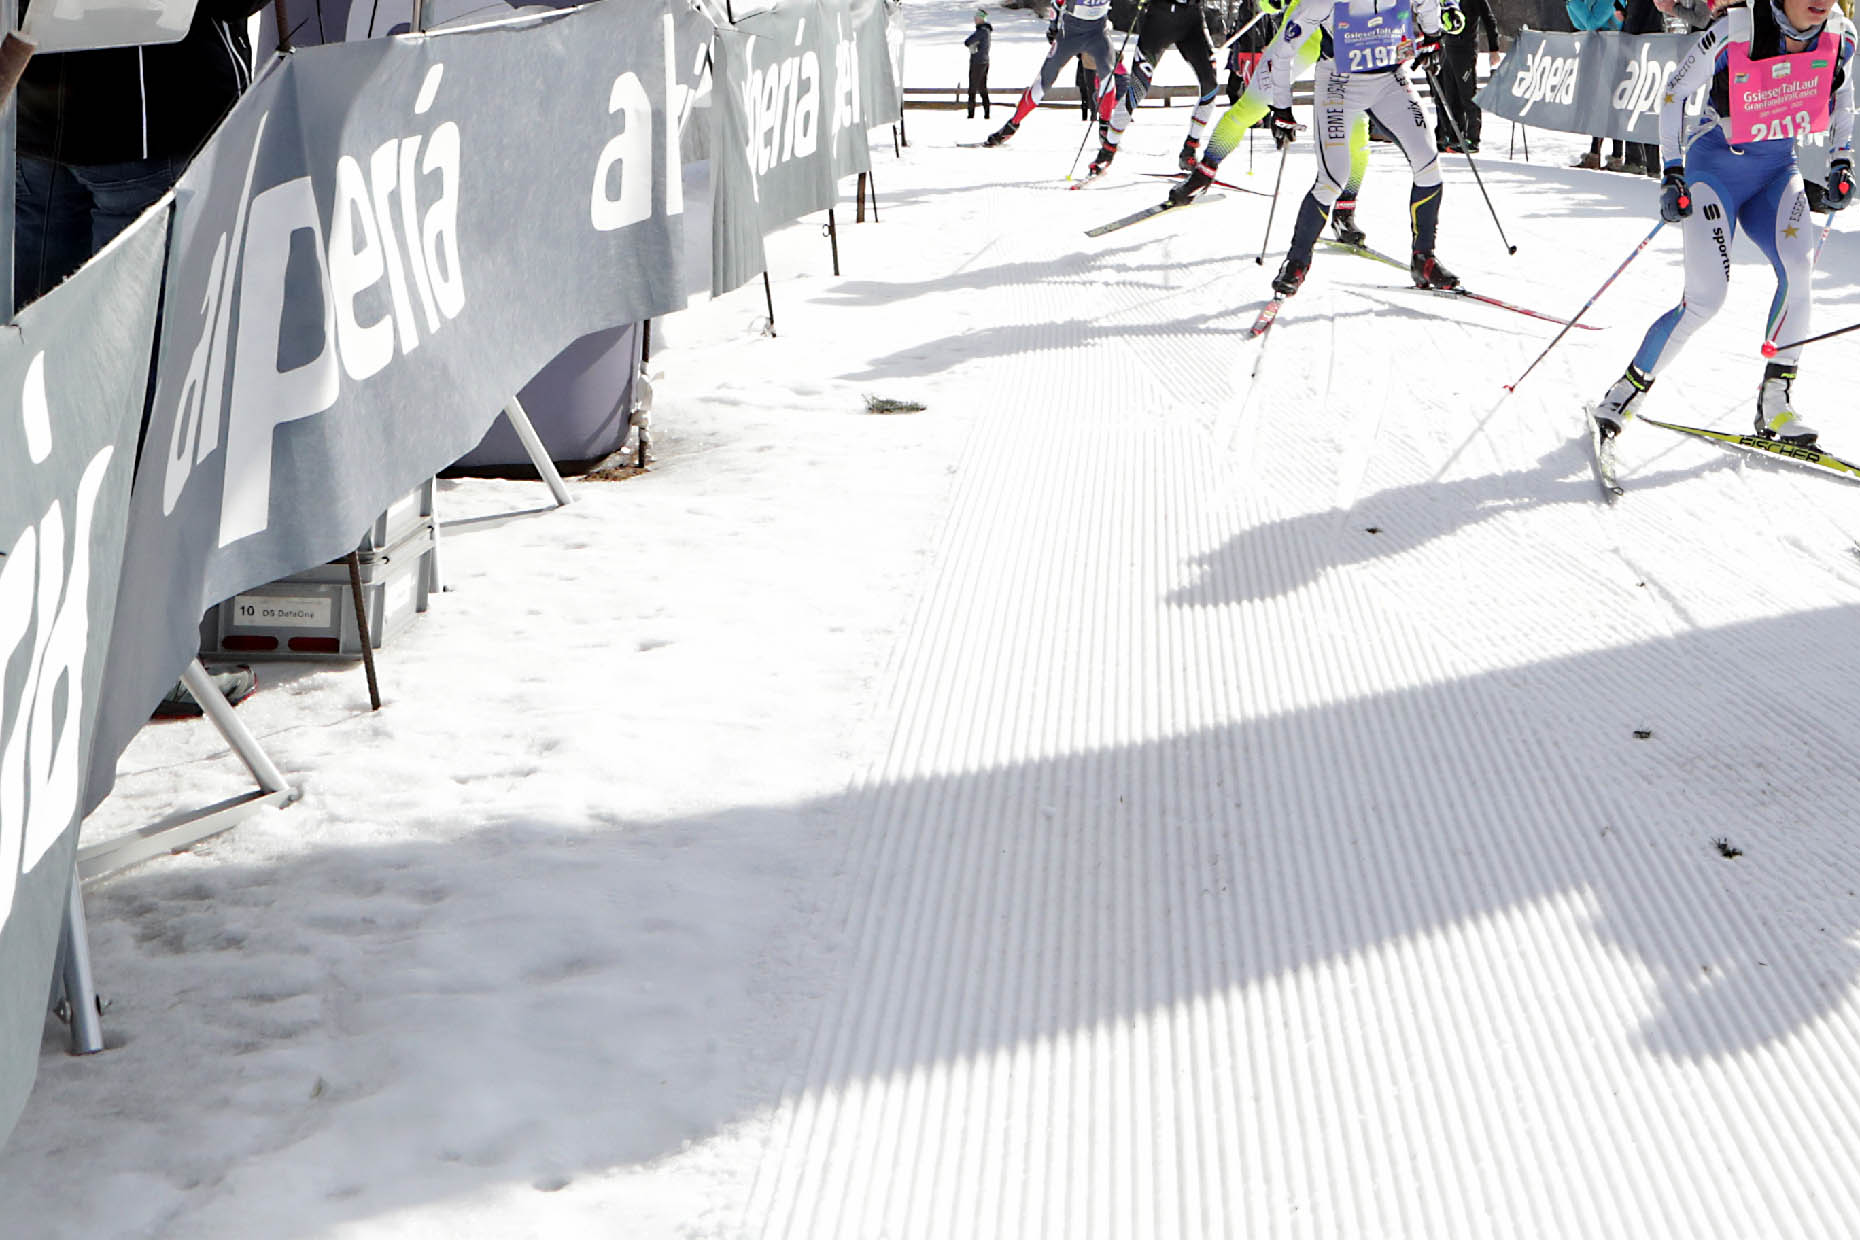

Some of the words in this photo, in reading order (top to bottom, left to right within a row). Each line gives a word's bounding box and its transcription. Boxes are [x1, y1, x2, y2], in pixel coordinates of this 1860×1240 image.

[1751, 110, 1811, 142] 2413
[163, 64, 467, 549] alperia
[240, 606, 255, 617] 10
